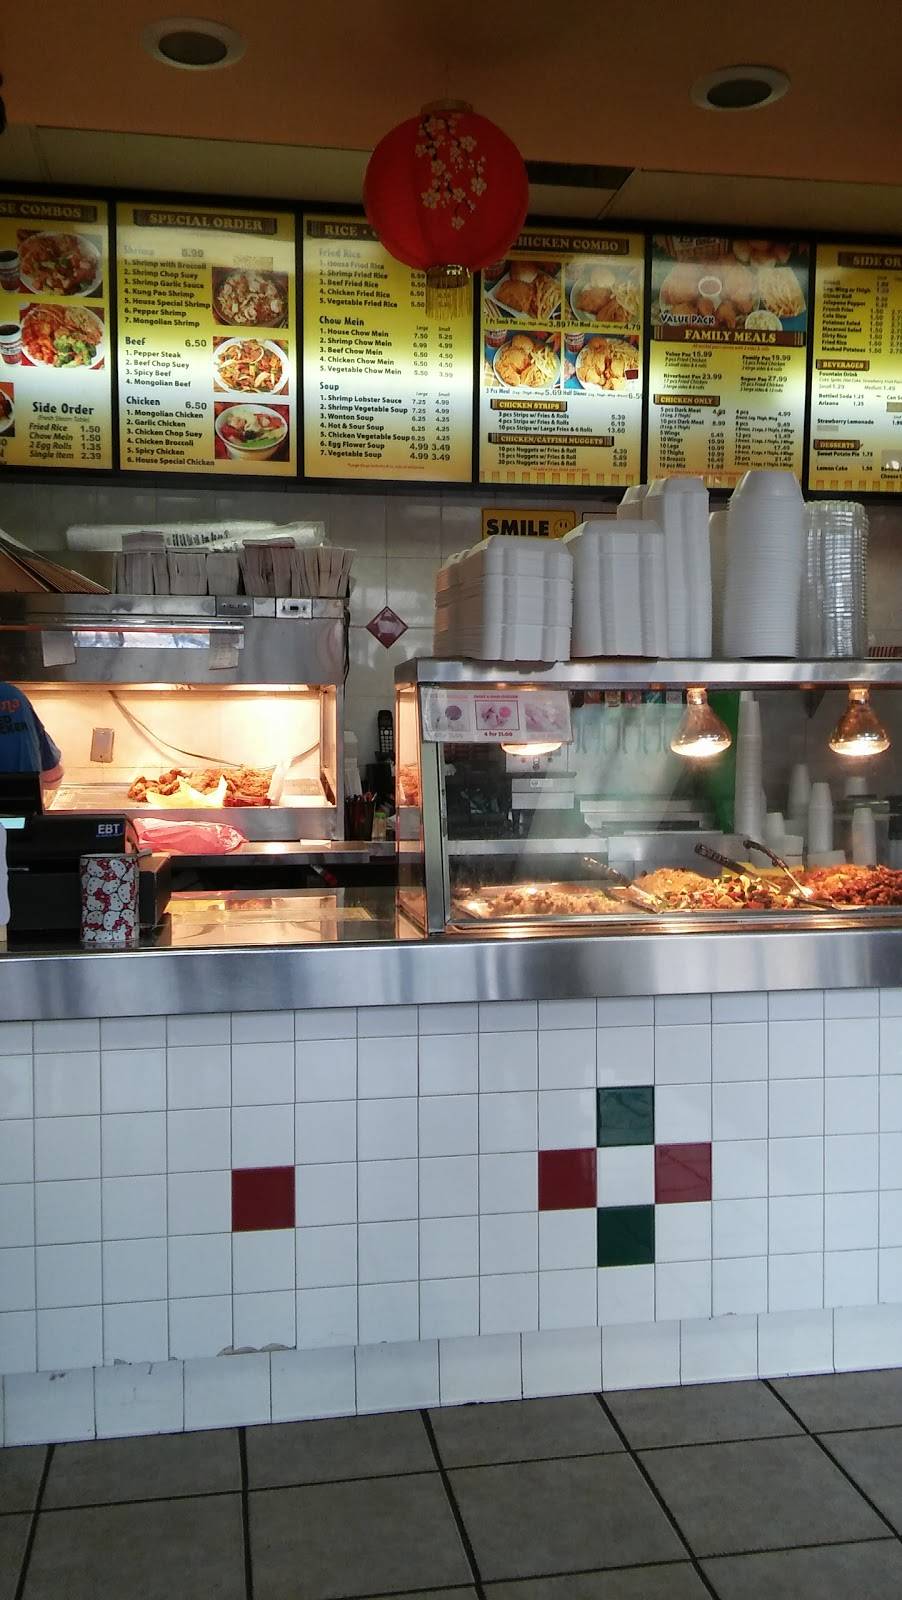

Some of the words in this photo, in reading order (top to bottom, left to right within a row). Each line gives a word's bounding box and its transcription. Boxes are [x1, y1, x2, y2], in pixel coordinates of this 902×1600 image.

[21, 204, 81, 217] COMBOS
[147, 213, 209, 226] SPECIAL
[213, 217, 262, 231] ORDER
[324, 225, 358, 236] RICE
[573, 239, 618, 251] COMBO
[132, 259, 158, 267] Shrimp
[160, 270, 178, 278] Chop
[181, 272, 197, 280] Suey
[327, 270, 353, 278] Shrimp
[160, 280, 181, 288] Garlic
[185, 301, 210, 309] Shrimp
[327, 298, 362, 307] Vegetable
[160, 309, 187, 317] Shrimp
[133, 318, 172, 326] Mongolian
[174, 320, 200, 328] Shrimp
[319, 316, 341, 325] Chow
[344, 317, 364, 326] Mein
[661, 312, 689, 324] VALUE
[691, 316, 715, 325] PACK
[685, 330, 731, 342] FAMILY
[734, 333, 776, 343] MEALS
[125, 337, 146, 346] Beef
[328, 338, 353, 346] Shrimp
[134, 379, 173, 387] Mongolian
[320, 382, 339, 390] Soup
[126, 396, 160, 405] Chicken
[186, 402, 207, 410] 6.50
[328, 395, 353, 403] Shrimp
[33, 402, 57, 413] Side
[61, 403, 94, 414] Order
[328, 404, 353, 412] Shrimp
[354, 405, 389, 413] Vegetable
[135, 410, 173, 418] Mongolian
[36, 442, 51, 450] Egg
[53, 442, 72, 450] Rolls
[432, 443, 450, 451] 3.49
[30, 450, 54, 459] Single
[410, 452, 428, 460] 4.99
[432, 453, 450, 461] 3.49
[487, 519, 549, 536] SMILE
[97, 823, 120, 834] EBT
